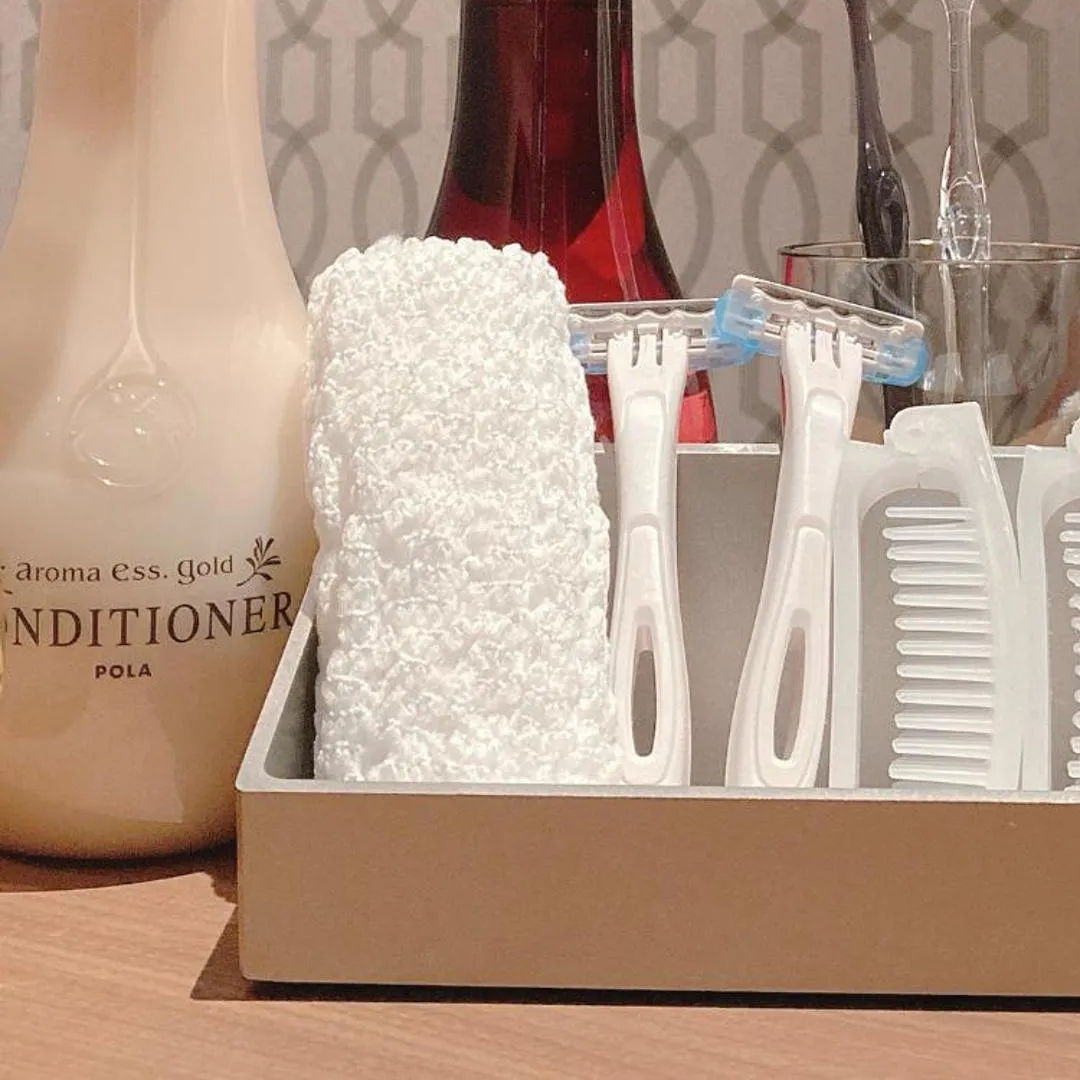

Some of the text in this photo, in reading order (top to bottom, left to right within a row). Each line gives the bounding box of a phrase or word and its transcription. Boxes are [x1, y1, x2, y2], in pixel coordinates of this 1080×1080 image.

[16, 555, 233, 585] aroma ess. gold
[0, 591, 294, 647] NDITIONER
[94, 663, 152, 679] POLA
